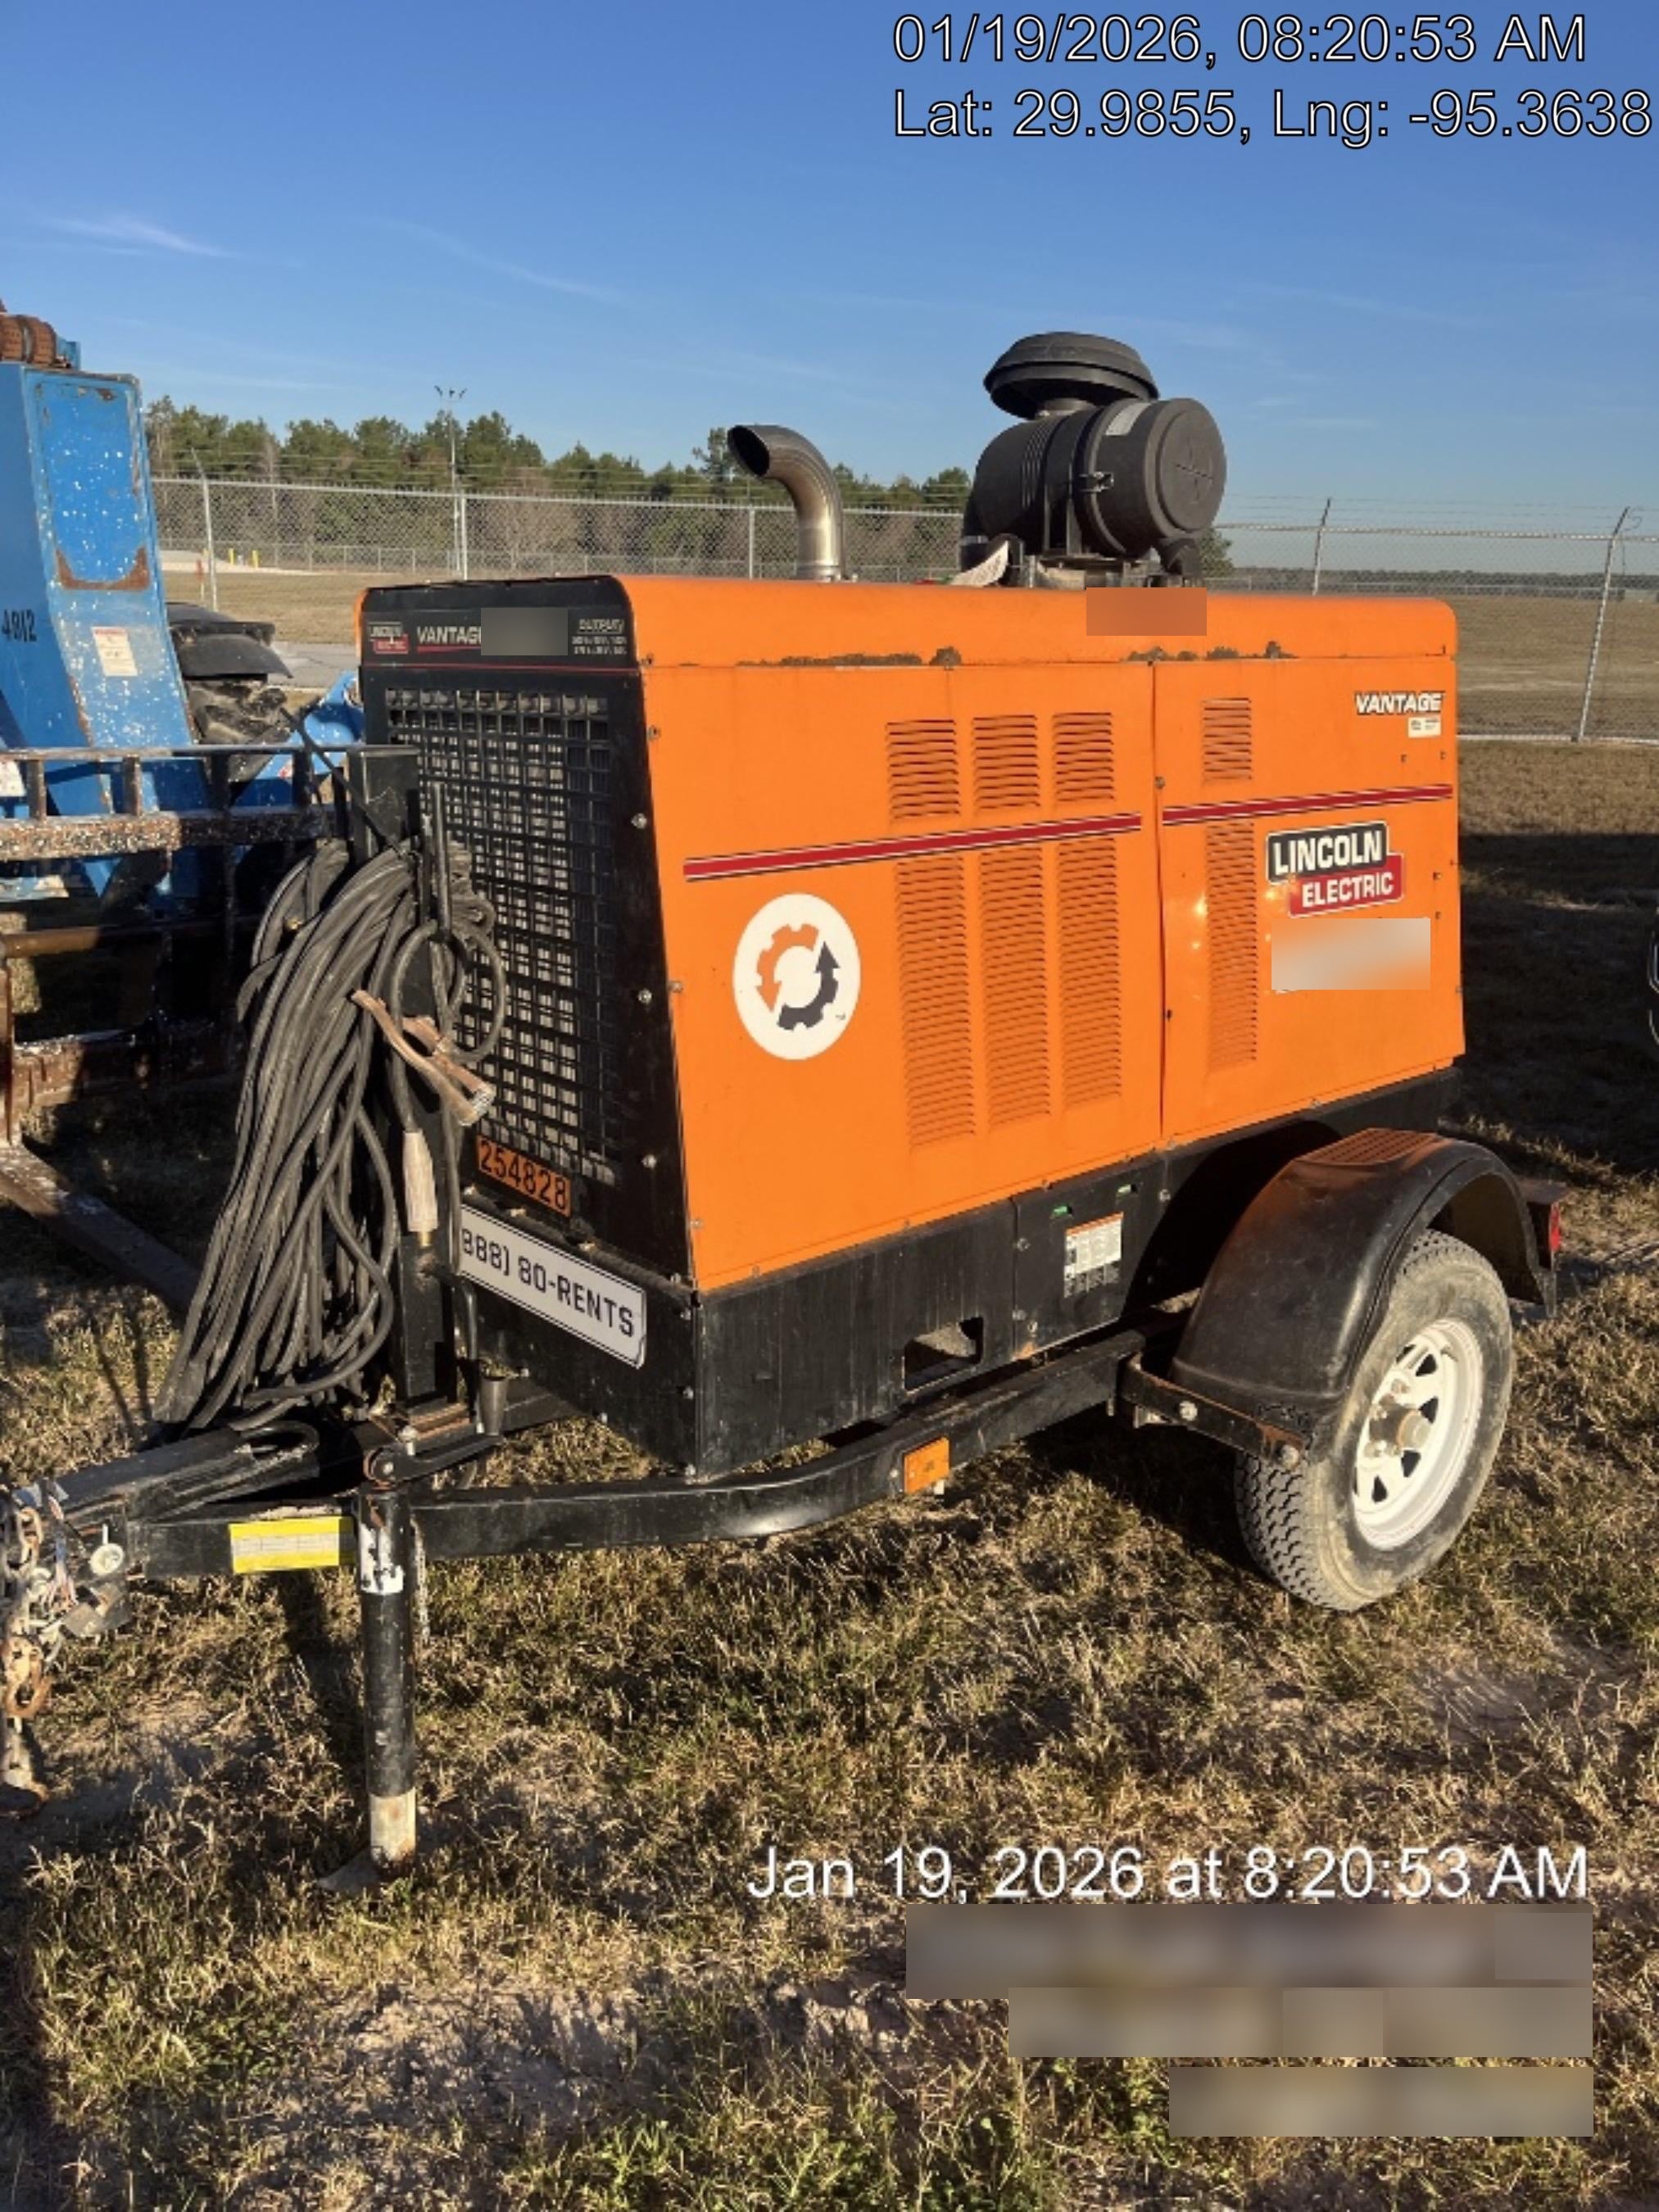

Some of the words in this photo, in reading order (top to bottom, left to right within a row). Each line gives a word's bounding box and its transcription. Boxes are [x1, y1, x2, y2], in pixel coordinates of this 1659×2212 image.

[1355, 691, 1443, 715] VANTAGE
[1273, 830, 1383, 876] LINCOLN
[1302, 871, 1394, 909] ELECTRIC
[480, 1138, 567, 1211] 254828
[517, 1255, 634, 1338] 80-RENTS
